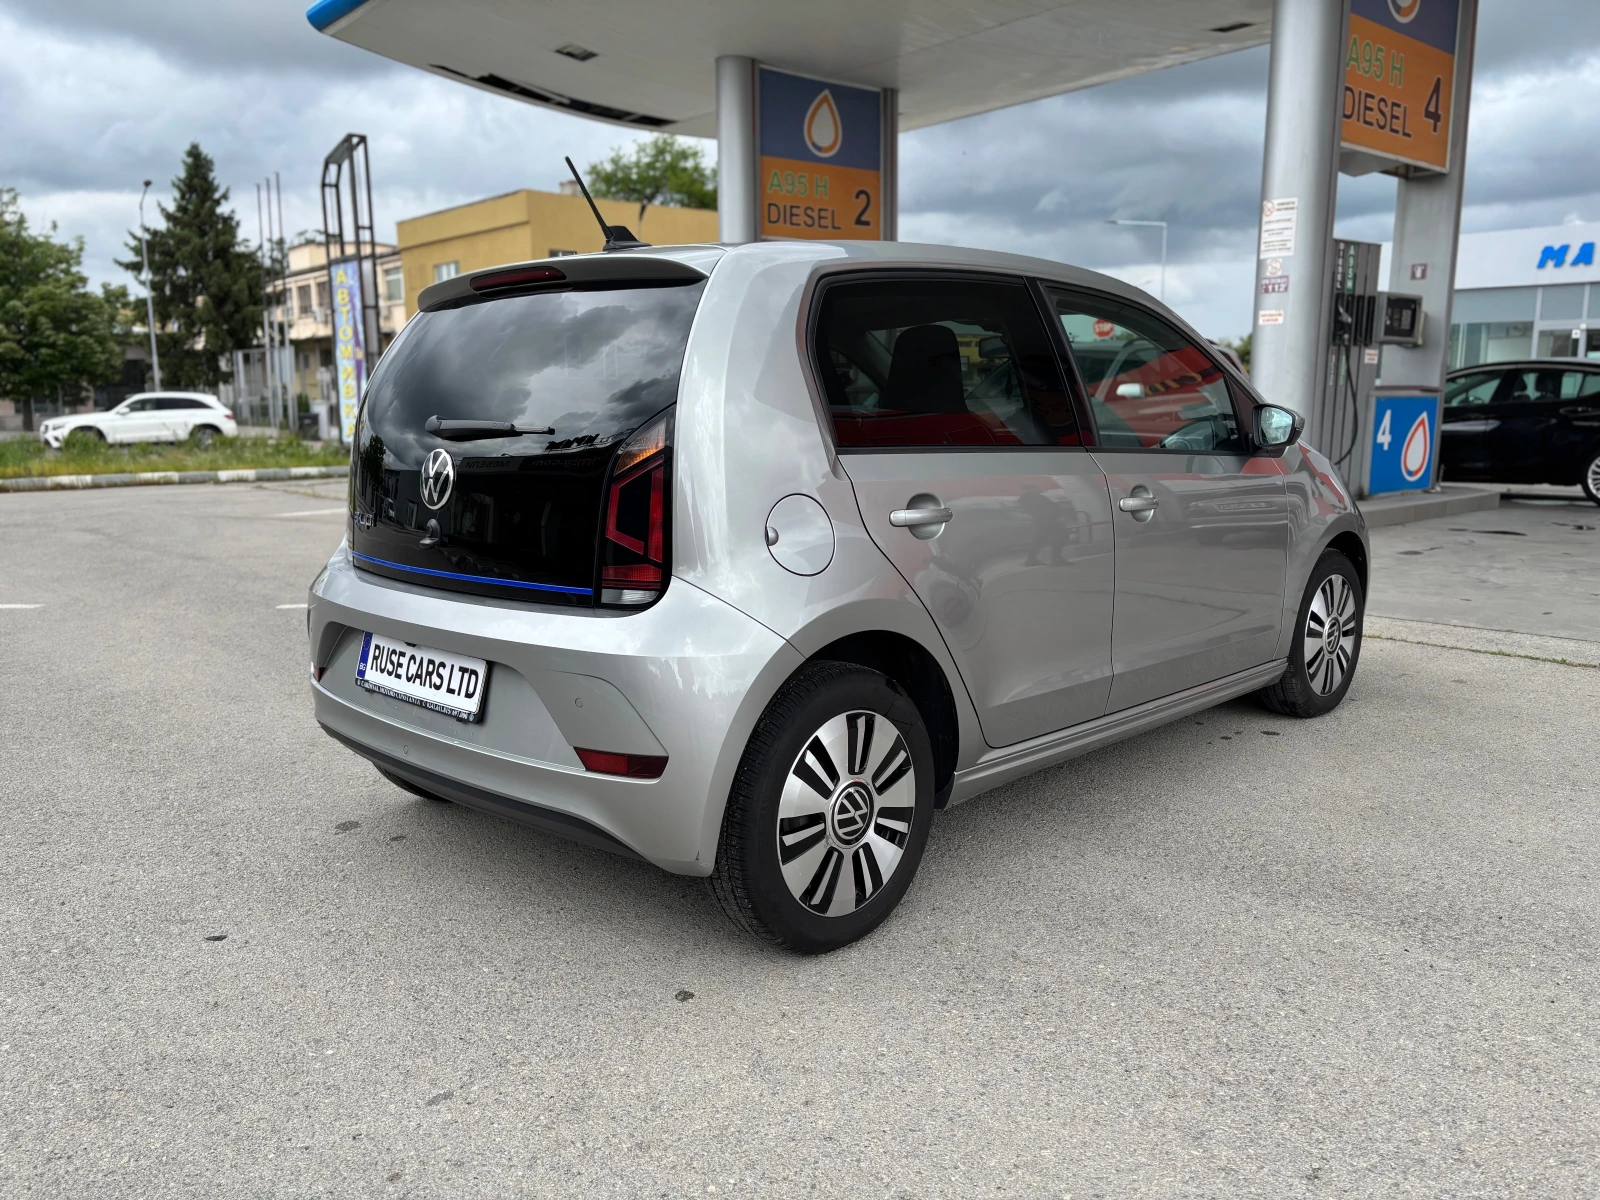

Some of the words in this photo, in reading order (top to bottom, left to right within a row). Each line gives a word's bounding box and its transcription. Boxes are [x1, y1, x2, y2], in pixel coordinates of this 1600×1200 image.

[1346, 35, 1385, 81] A95
[1389, 50, 1405, 88] H
[1342, 84, 1412, 138] DIESEL
[1423, 76, 1442, 133] 4
[767, 169, 809, 197] A95
[814, 175, 829, 199] H
[767, 202, 842, 231] DIESEL
[854, 189, 871, 227] 2
[1094, 322, 1112, 333] STOP
[335, 269, 356, 438] АВТОМИВКА
[1376, 408, 1392, 451] 4
[359, 662, 367, 671] BG
[370, 643, 407, 680] RUSE
[405, 654, 447, 691] CARS
[445, 664, 479, 699] LTD
